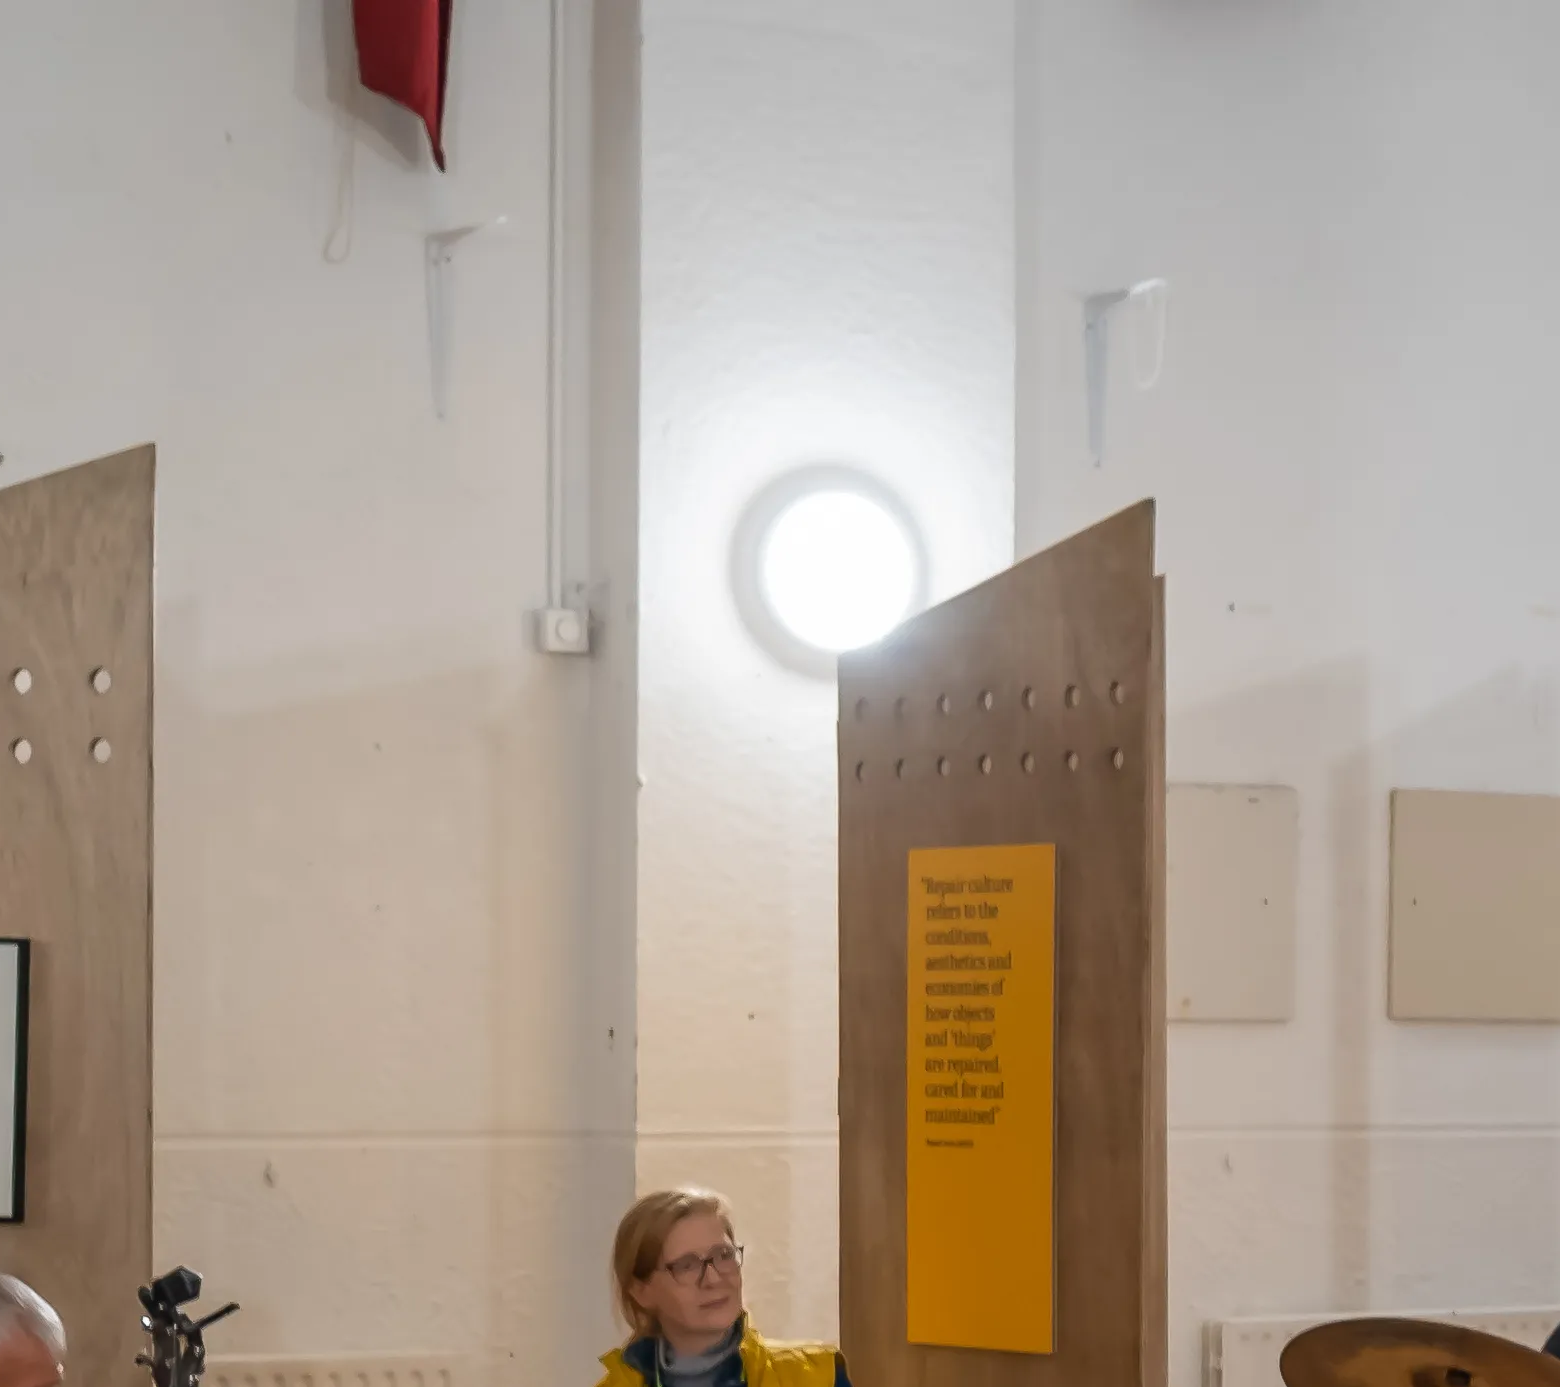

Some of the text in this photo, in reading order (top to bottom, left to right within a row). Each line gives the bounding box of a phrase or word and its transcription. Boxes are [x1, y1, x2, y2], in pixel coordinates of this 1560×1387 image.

[965, 904, 976, 918] to
[978, 901, 998, 918] the
[988, 950, 1011, 970] and
[925, 1029, 947, 1047] and
